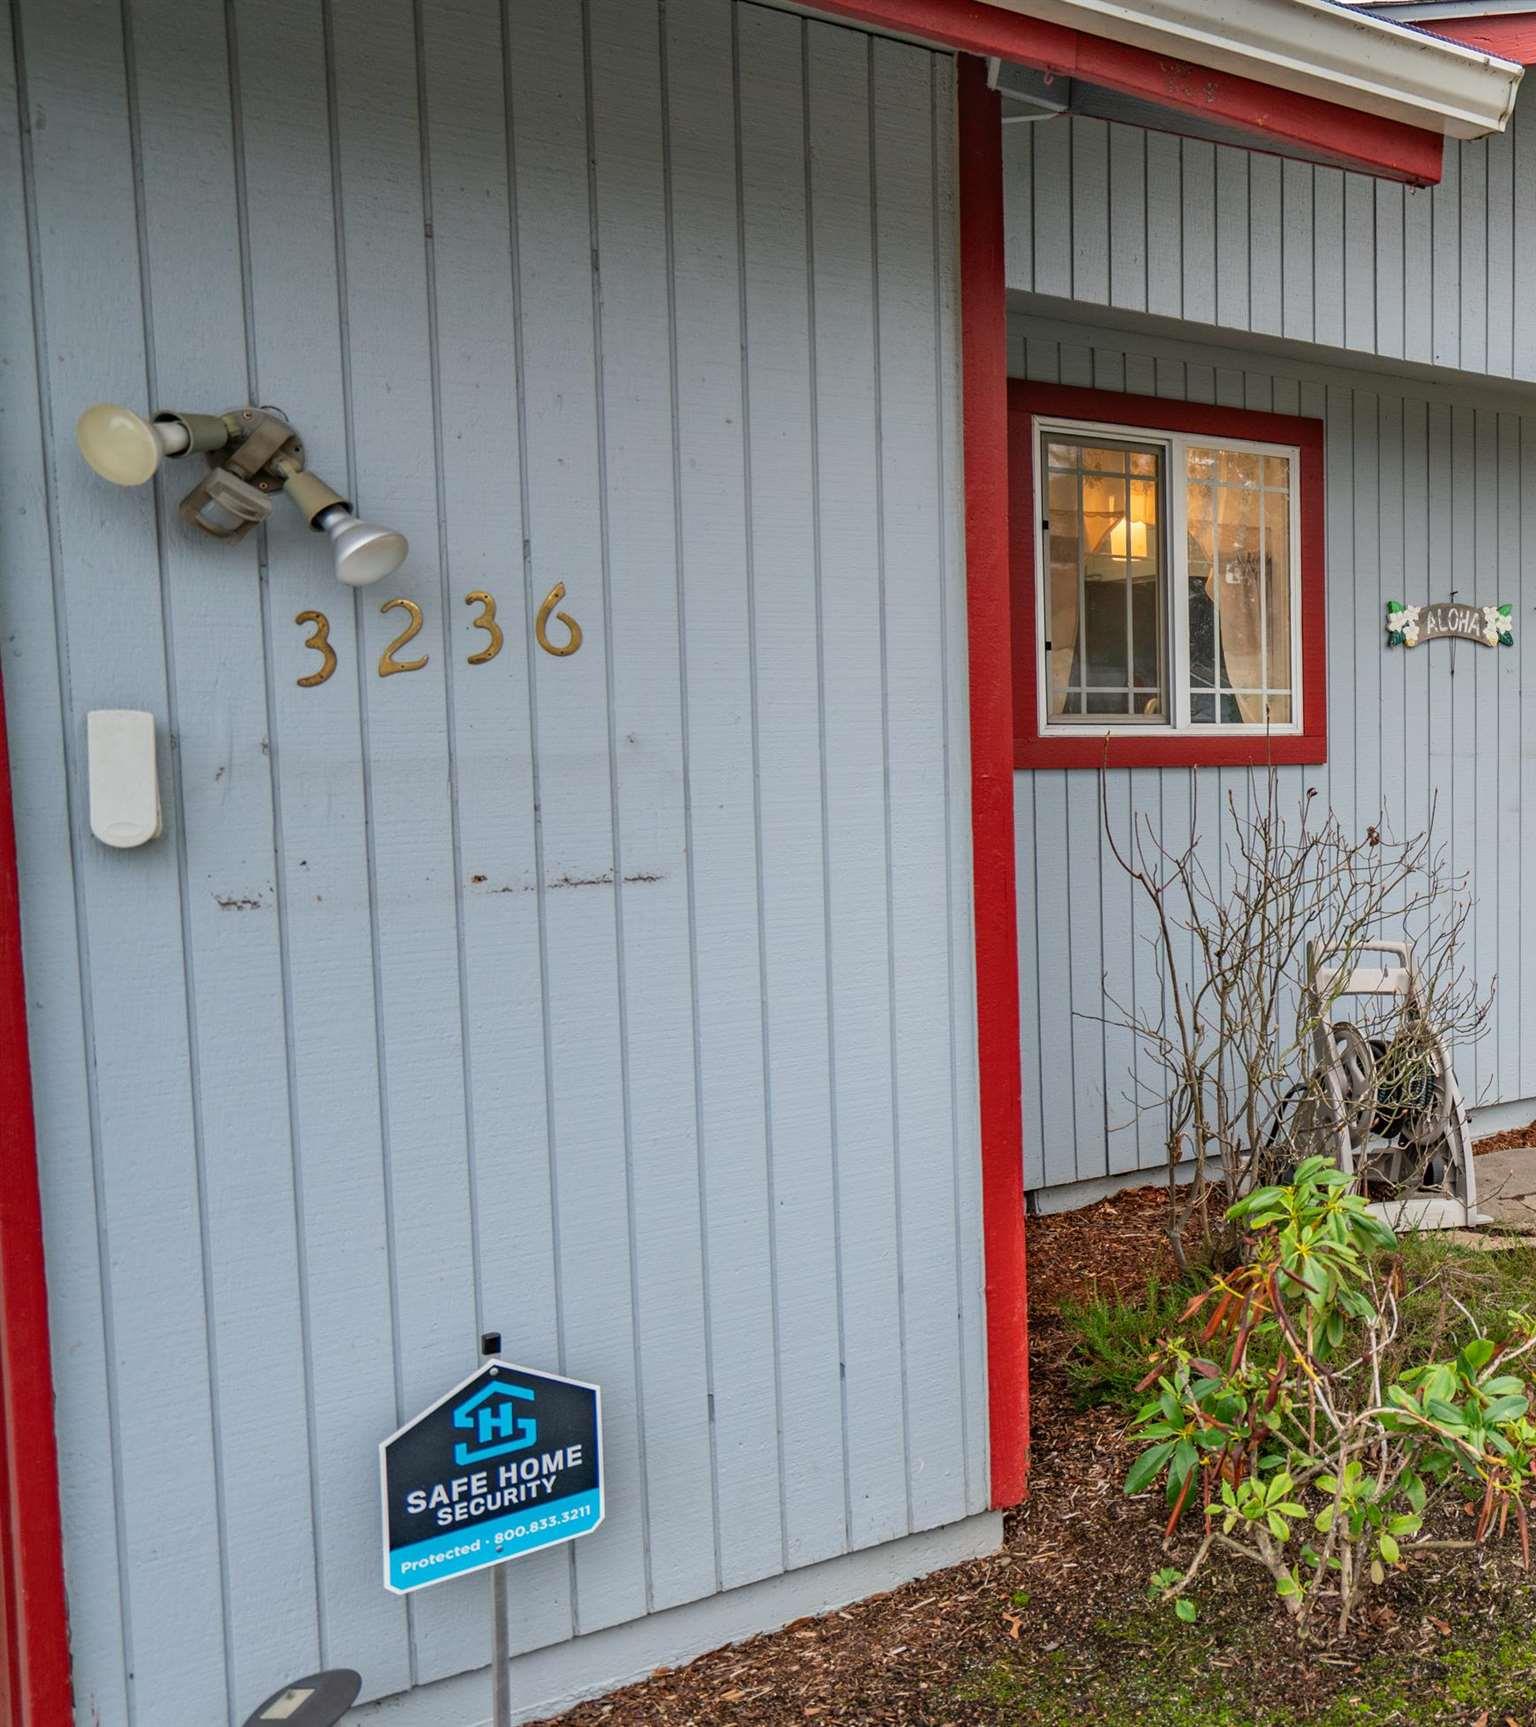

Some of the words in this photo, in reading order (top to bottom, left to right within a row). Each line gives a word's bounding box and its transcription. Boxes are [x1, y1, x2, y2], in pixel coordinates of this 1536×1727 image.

[295, 581, 583, 688] 3236
[1427, 607, 1481, 636] ALOHA
[407, 1471, 488, 1514] SAFE
[499, 1444, 583, 1487] HOME
[437, 1475, 557, 1526] SECURITY
[401, 1538, 481, 1574] Protected
[494, 1504, 592, 1545] 800.833.3211
